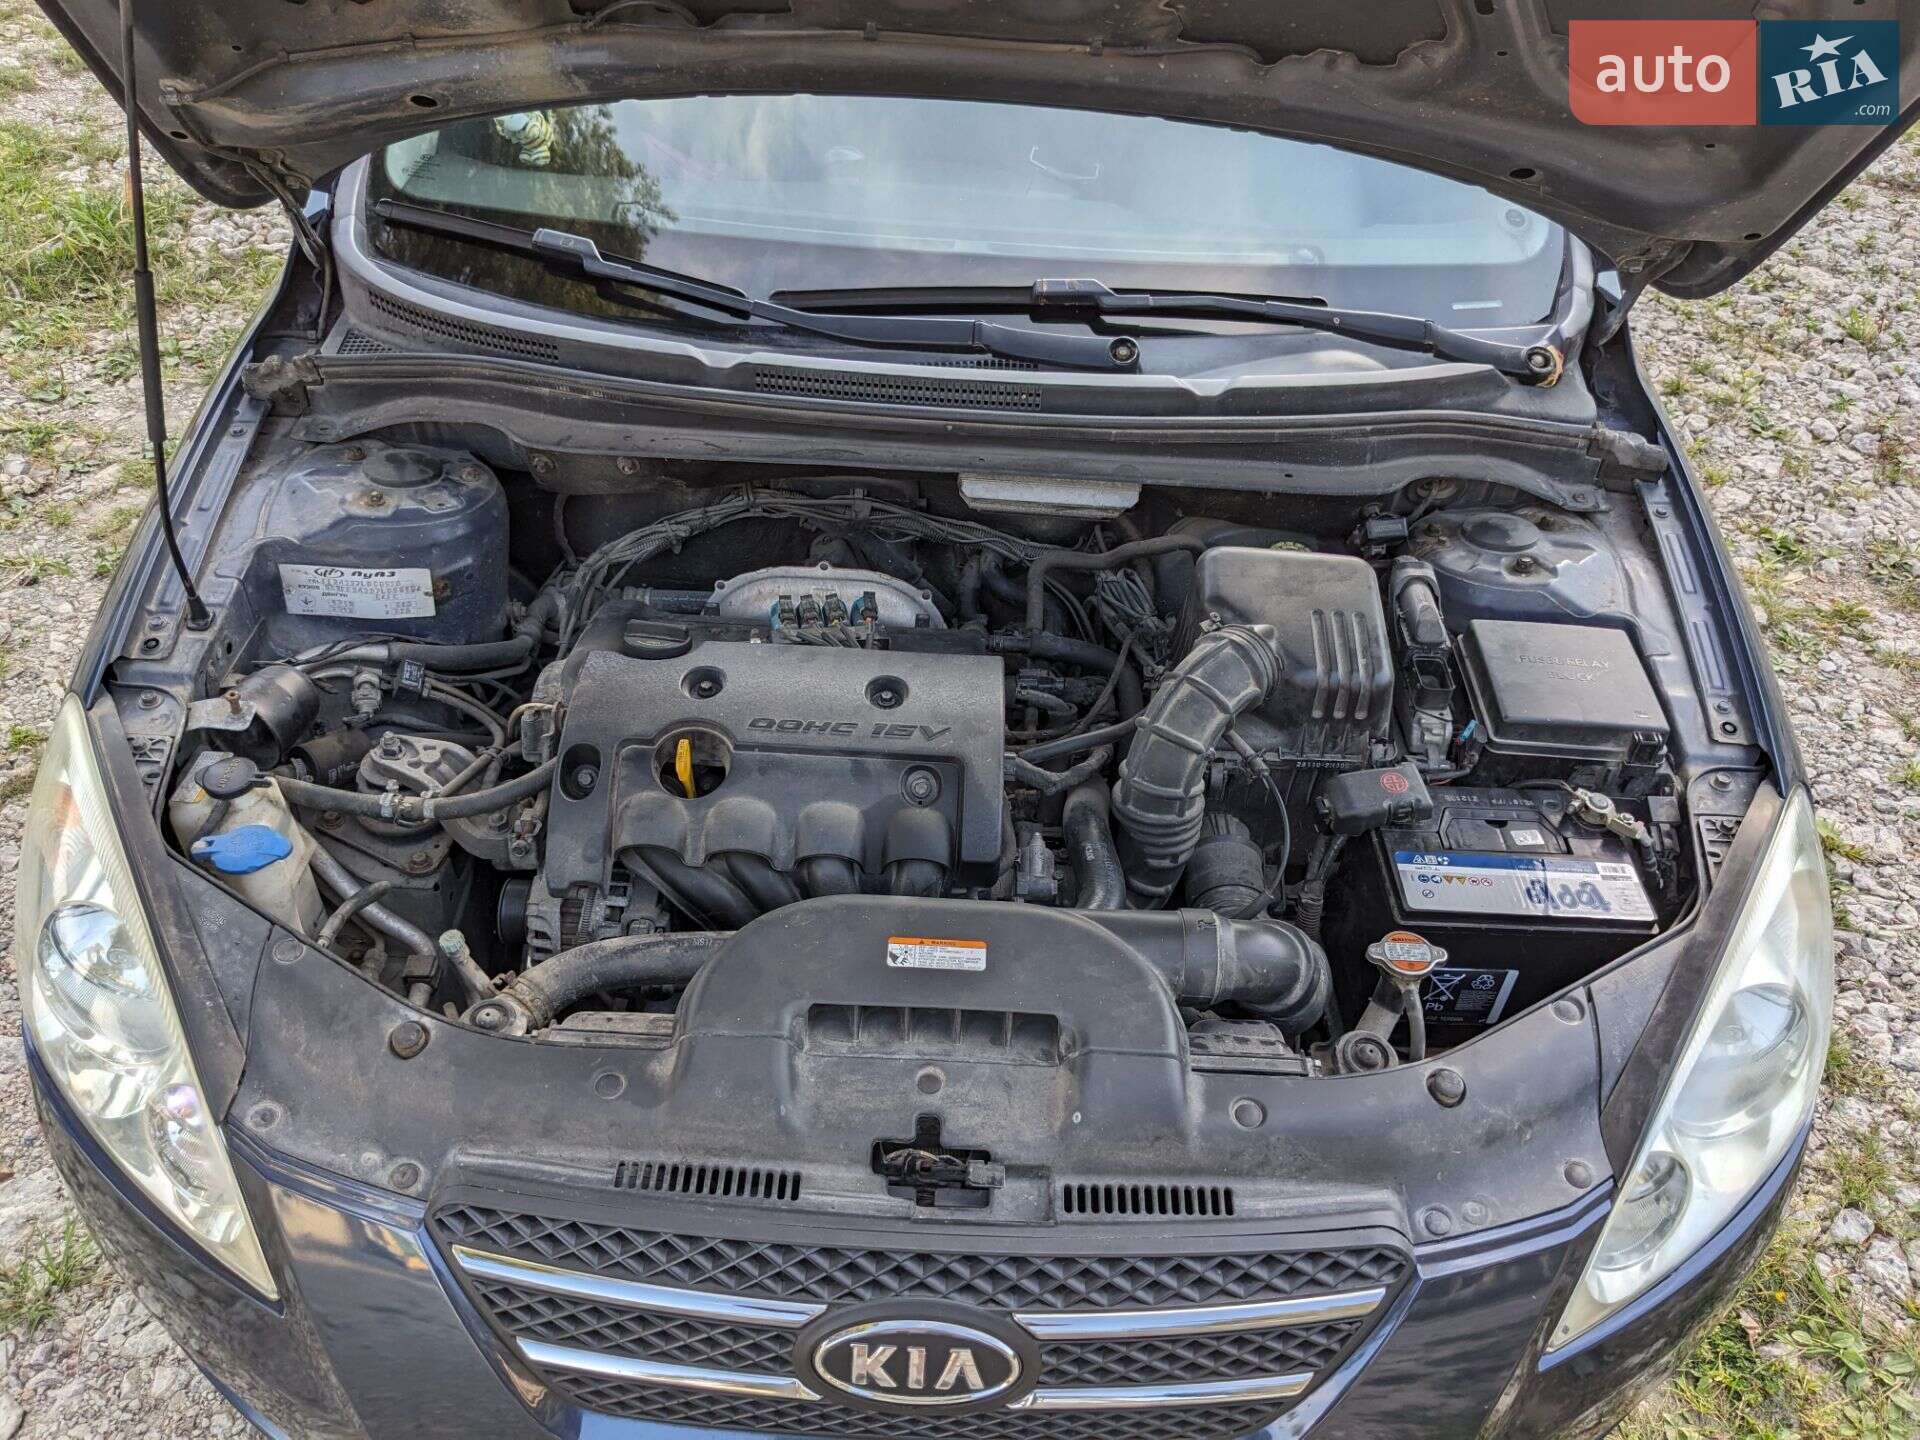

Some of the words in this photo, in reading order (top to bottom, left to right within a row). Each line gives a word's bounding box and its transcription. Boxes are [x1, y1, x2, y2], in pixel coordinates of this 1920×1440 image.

[747, 717, 858, 736] DOHC
[871, 722, 952, 742] 16V
[1425, 1002, 1444, 1012] Pb
[849, 1342, 985, 1391] KIA
